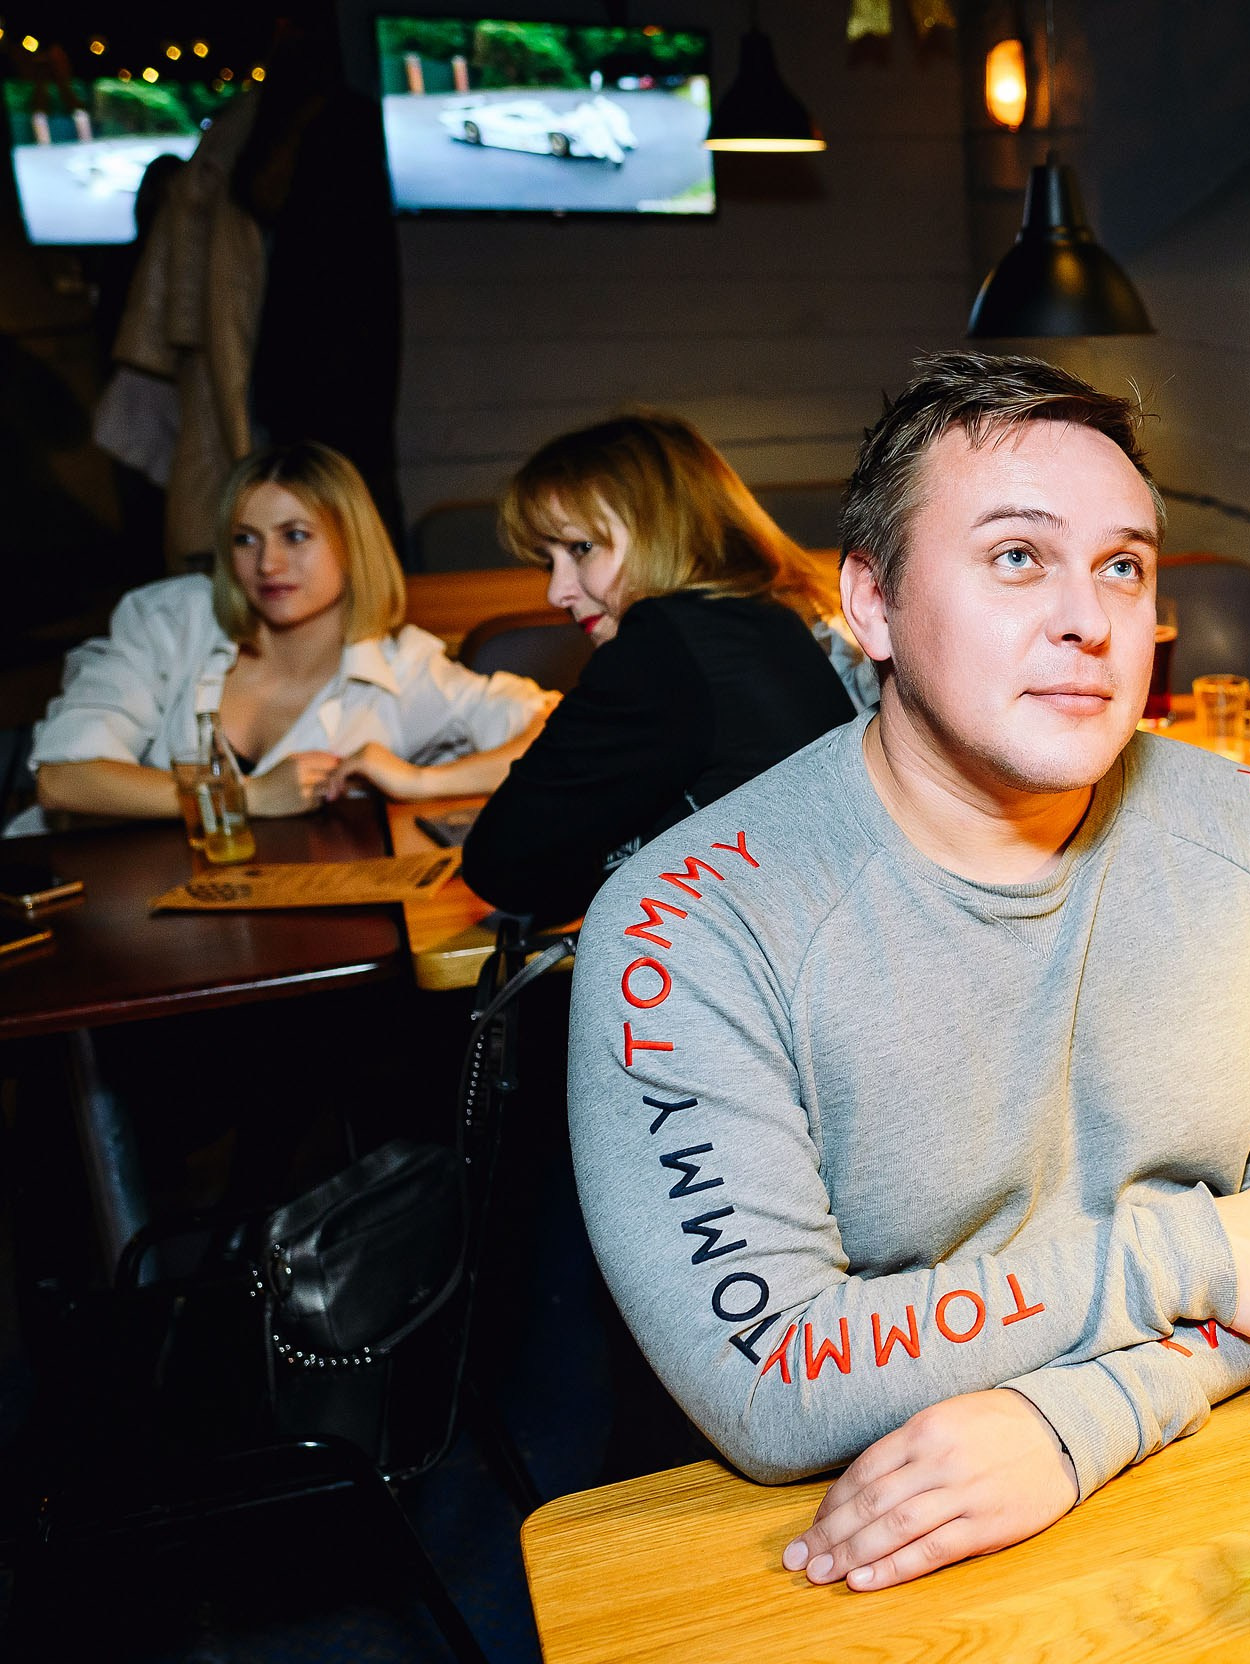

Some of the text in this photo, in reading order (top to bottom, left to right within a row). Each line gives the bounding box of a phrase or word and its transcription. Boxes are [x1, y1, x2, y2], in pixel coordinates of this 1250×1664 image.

[621, 831, 760, 1067] TOMMY
[642, 1095, 782, 1366] TOMMY
[761, 1273, 1045, 1384] TOMMY
